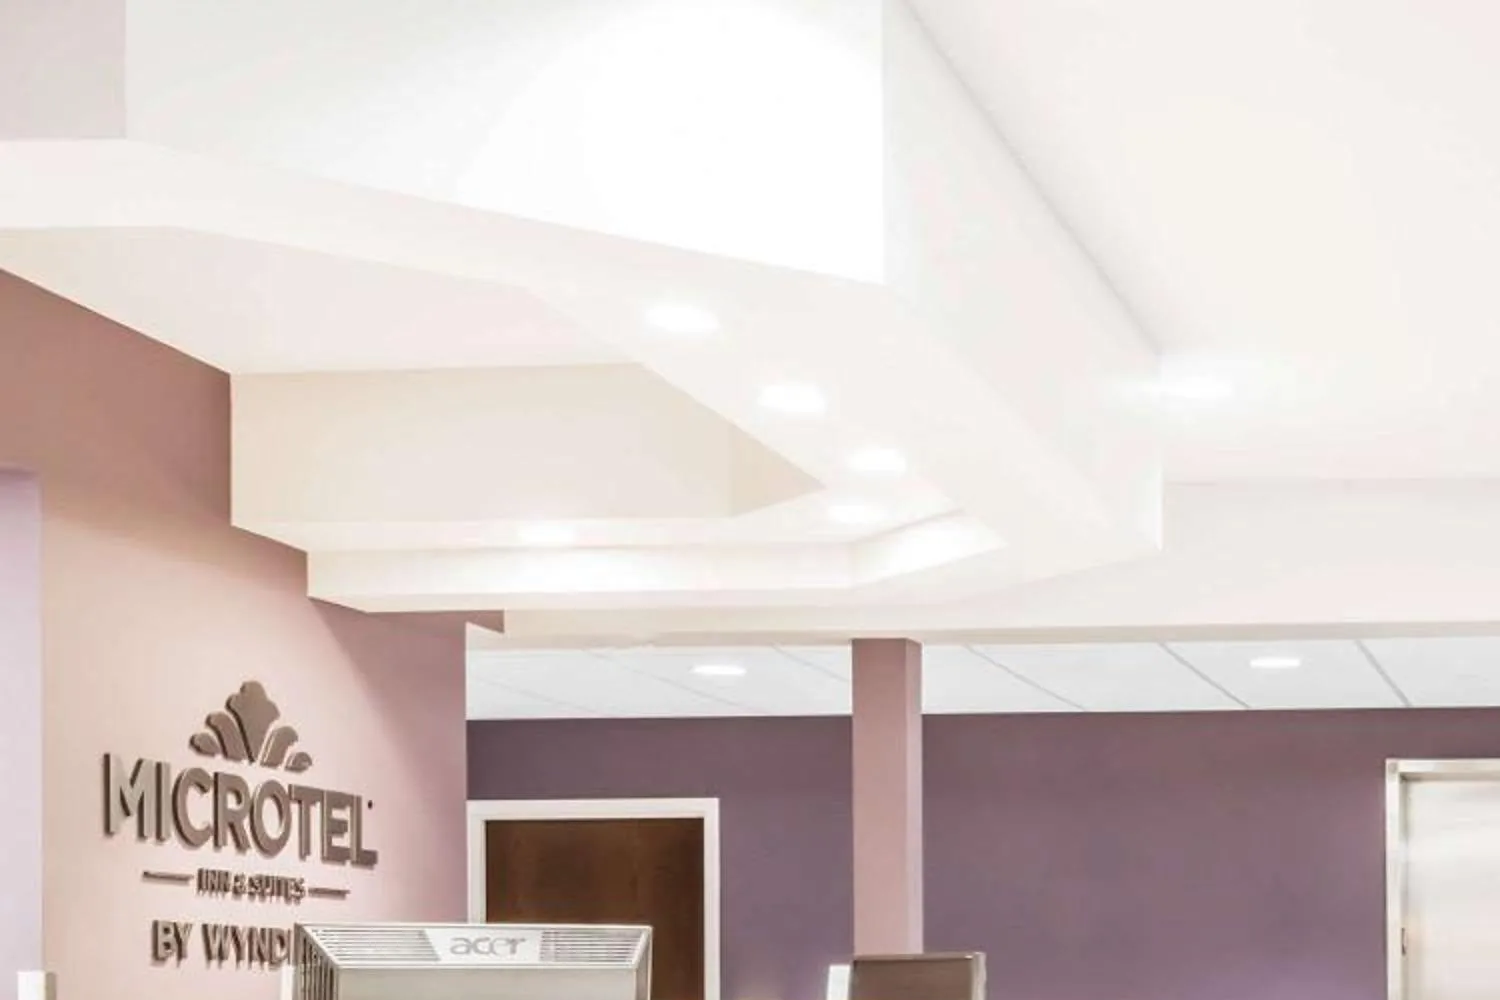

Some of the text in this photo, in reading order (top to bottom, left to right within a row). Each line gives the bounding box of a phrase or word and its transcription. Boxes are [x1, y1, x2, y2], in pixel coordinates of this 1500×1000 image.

[103, 753, 378, 868] MICROTEL
[197, 868, 231, 894] INN
[248, 874, 305, 903] SUITES
[152, 919, 293, 967] BY WYND
[450, 936, 527, 956] acer
